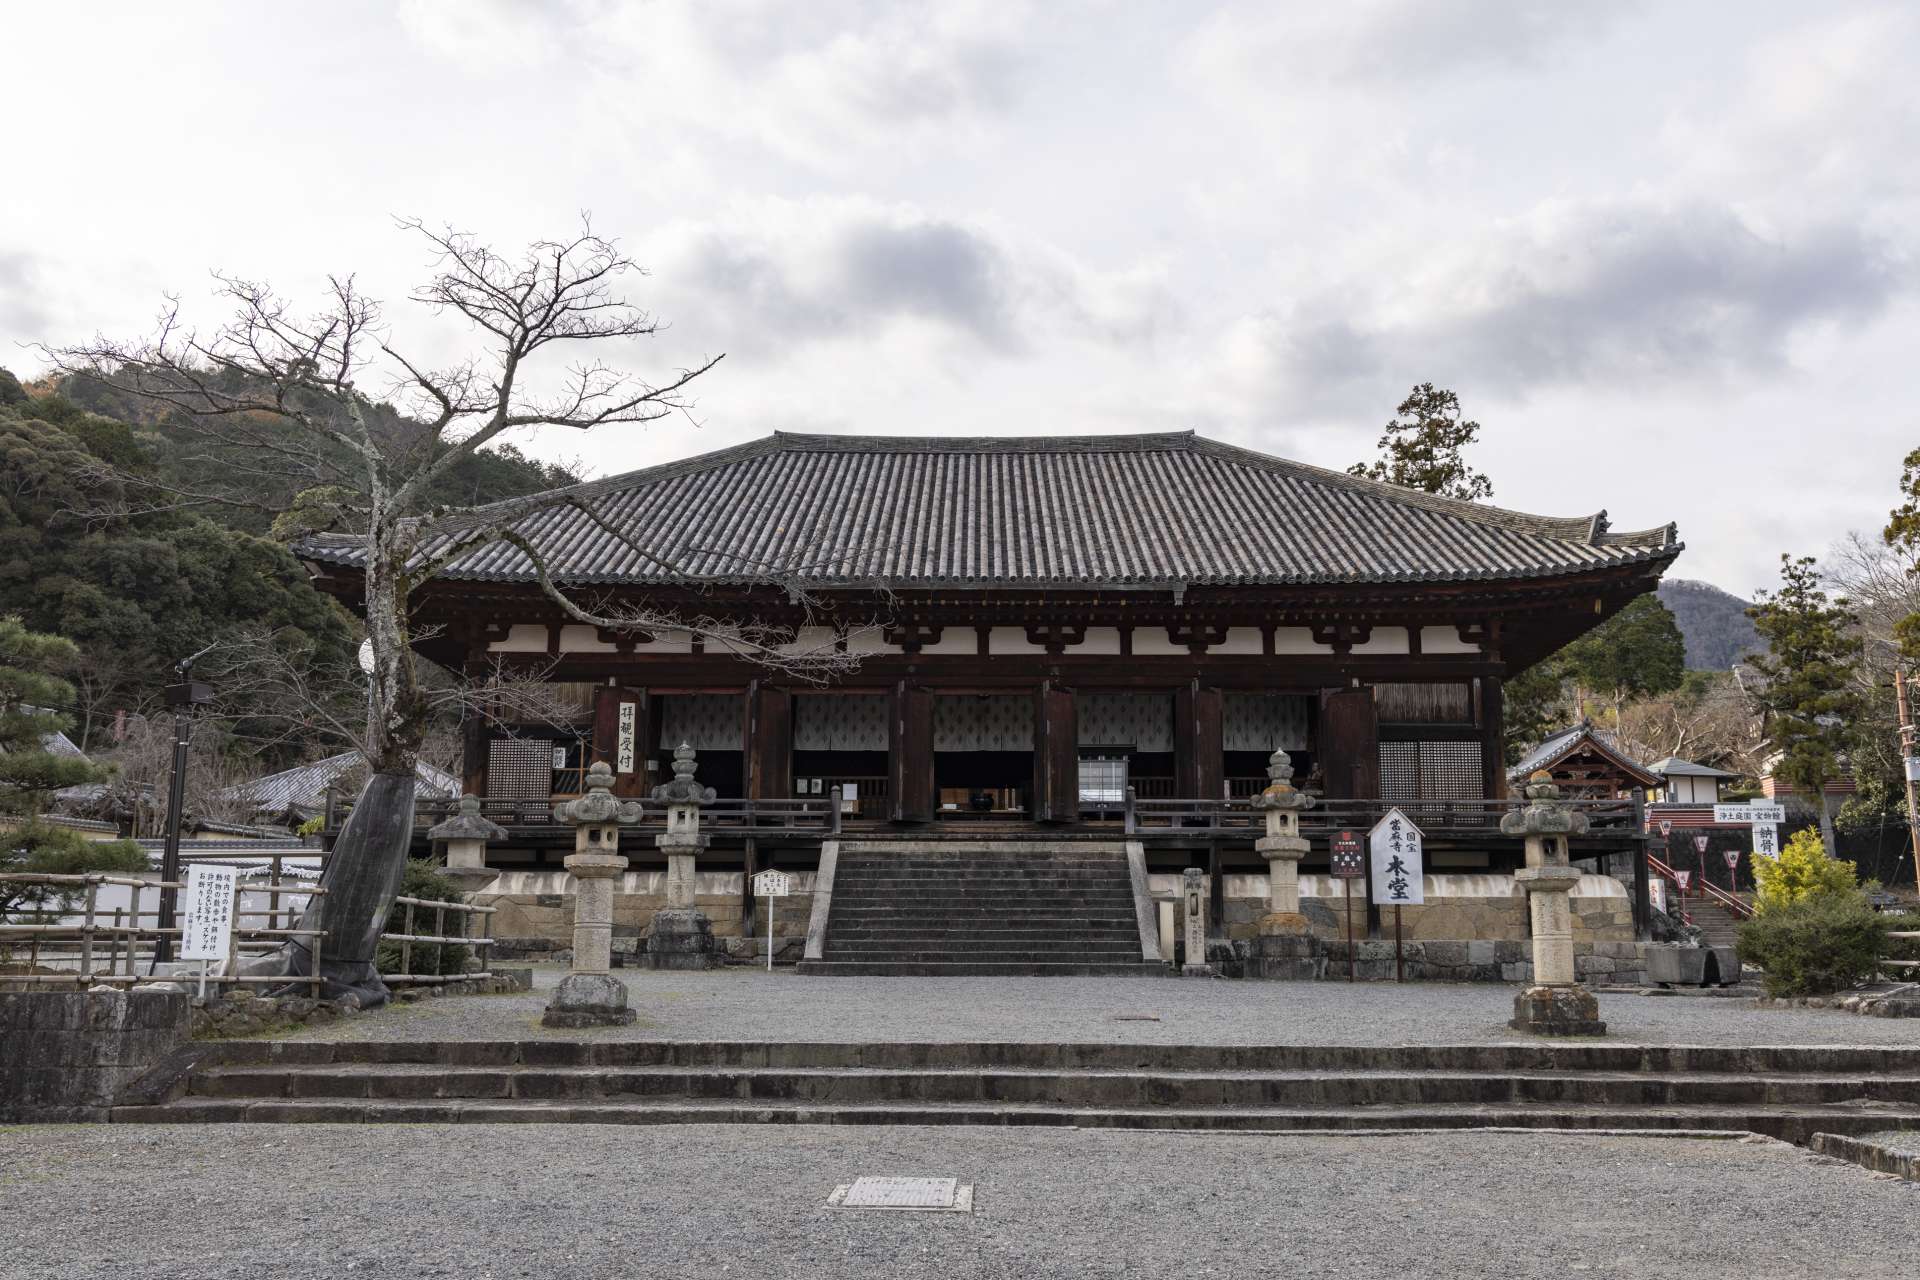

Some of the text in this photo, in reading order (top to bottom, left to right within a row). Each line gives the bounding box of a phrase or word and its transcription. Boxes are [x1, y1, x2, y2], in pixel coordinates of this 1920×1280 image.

[1385, 818, 1410, 900] 當麻寺 本堂
